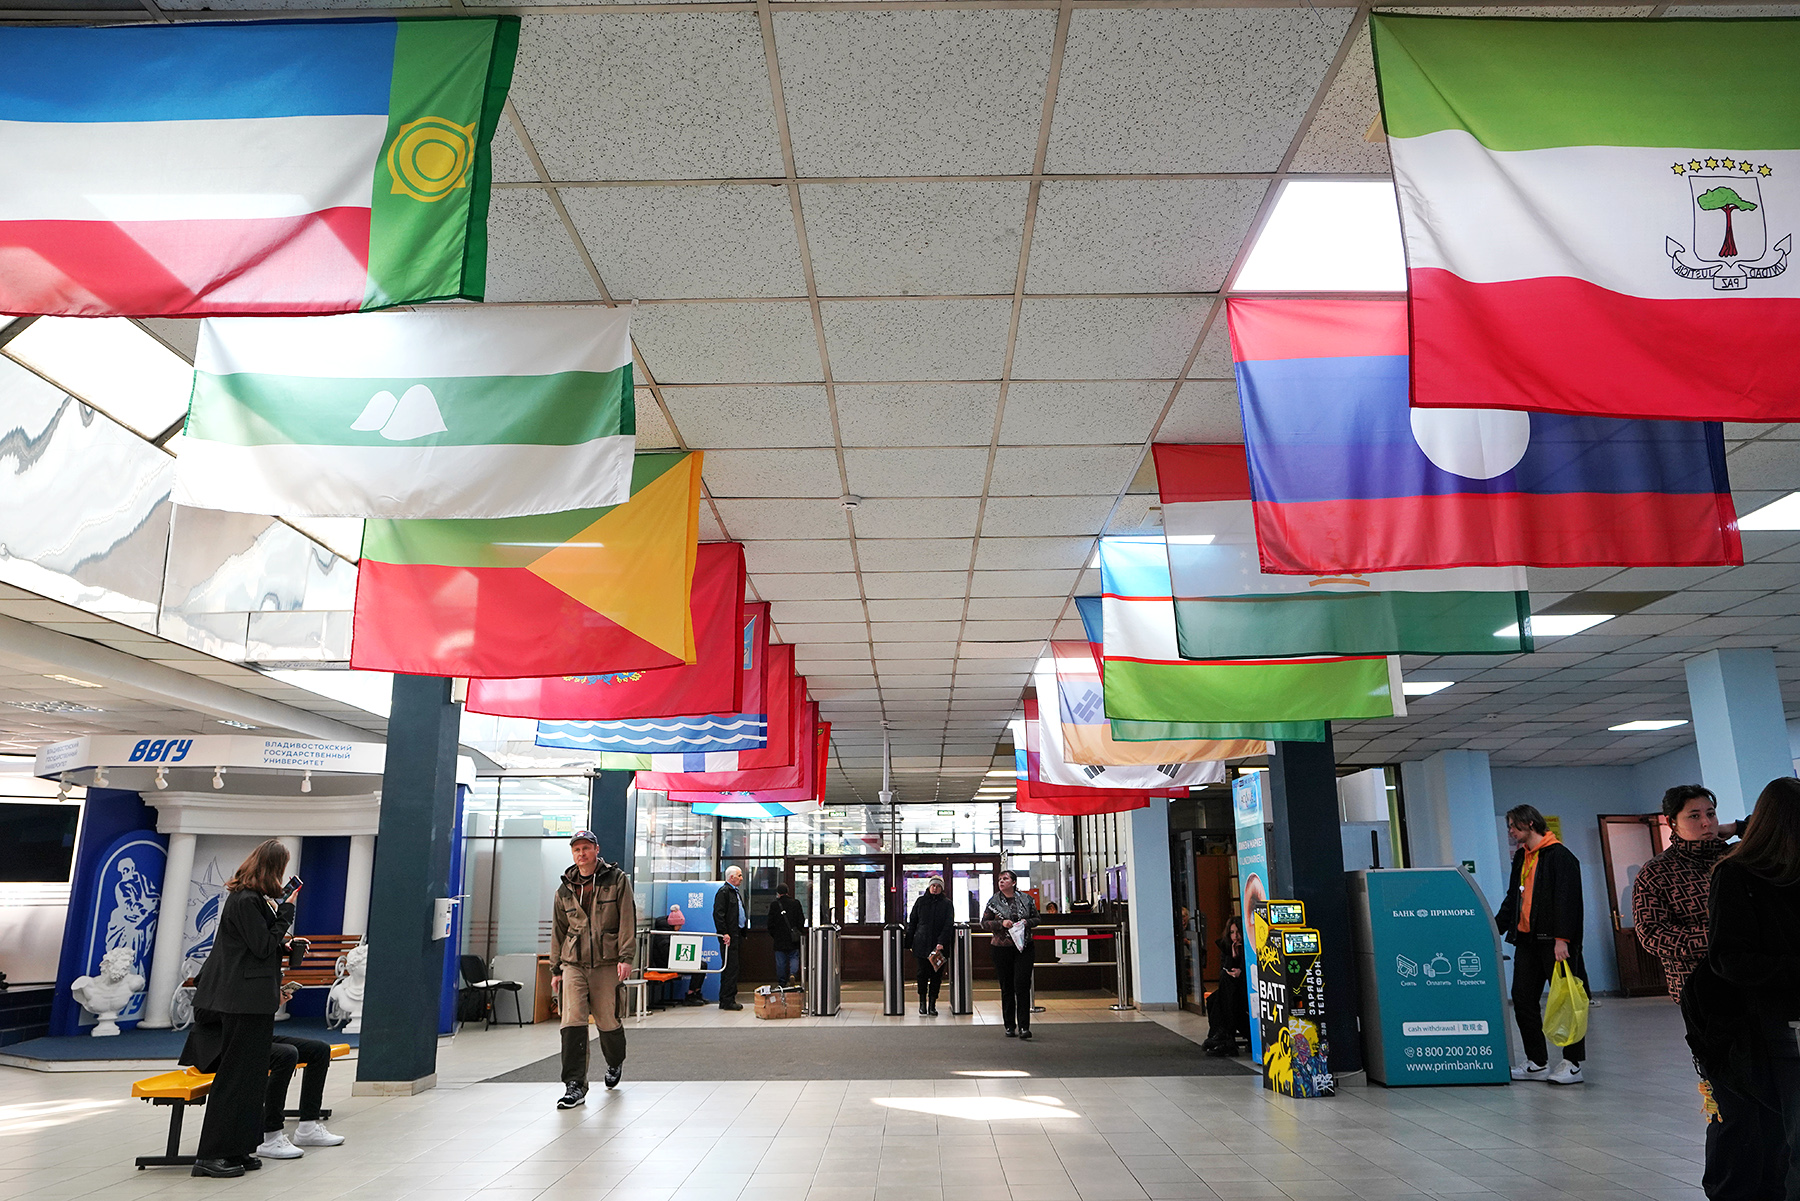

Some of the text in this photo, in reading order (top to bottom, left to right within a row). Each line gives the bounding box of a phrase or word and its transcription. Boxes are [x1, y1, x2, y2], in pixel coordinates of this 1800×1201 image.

[128, 739, 194, 762] ВВГУ
[265, 741, 352, 752] ВЛАДИВОСТОКСКИЙ
[263, 749, 351, 759] ГОСУДАРСТВЕННЫЙ
[263, 757, 325, 766] УНИВЕРСИТЕТ
[1392, 909, 1476, 918] БАНК ПРИМОРЬЕ
[1314, 961, 1326, 1016] ТЕЛЕФОН
[1457, 979, 1486, 987] Перевести
[1259, 980, 1286, 1003] BATT
[1306, 968, 1316, 1016] ЗАРЯДИ
[1407, 1024, 1456, 1033] cash withdrawal
[1461, 1023, 1484, 1032] 取现金
[1416, 1047, 1423, 1057] 8
[1424, 1046, 1444, 1057] 800
[1445, 1046, 1464, 1057] 200
[1465, 1045, 1478, 1056] 20
[1479, 1045, 1493, 1056] 86
[1405, 1060, 1494, 1073] www.primbank.ru
